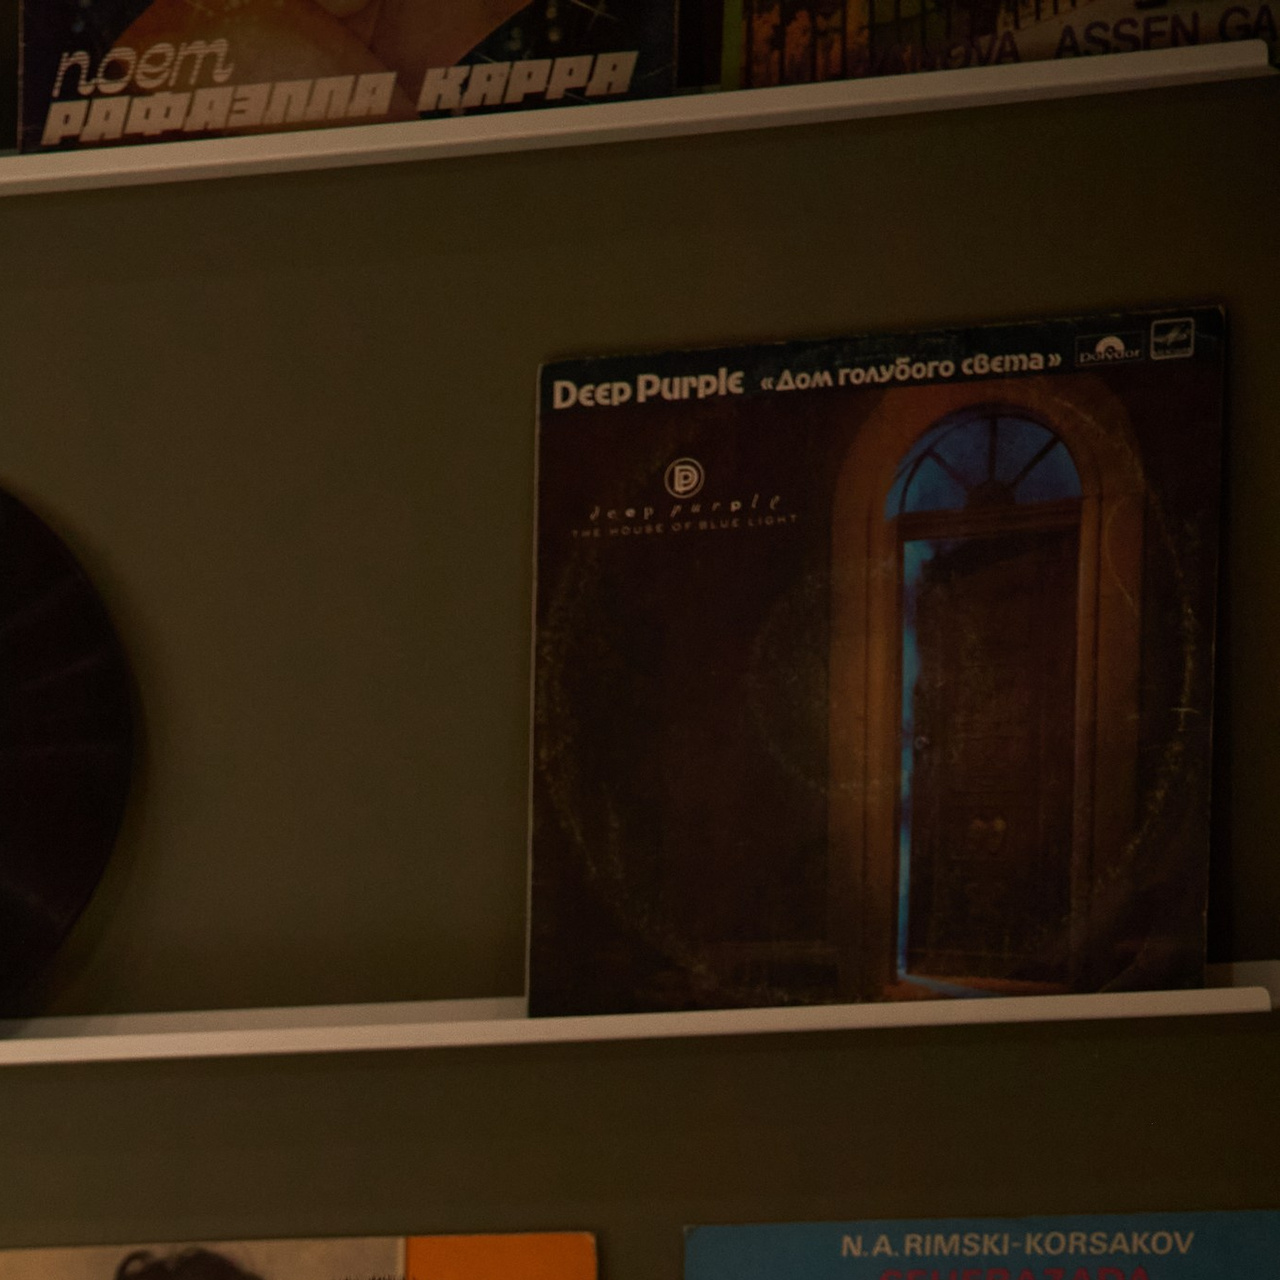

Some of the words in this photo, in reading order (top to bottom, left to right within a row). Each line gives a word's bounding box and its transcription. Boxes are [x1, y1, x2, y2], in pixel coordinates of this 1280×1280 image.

[417, 50, 640, 113] КАРРА
[636, 366, 746, 404] Purple
[837, 356, 956, 387] голубого
